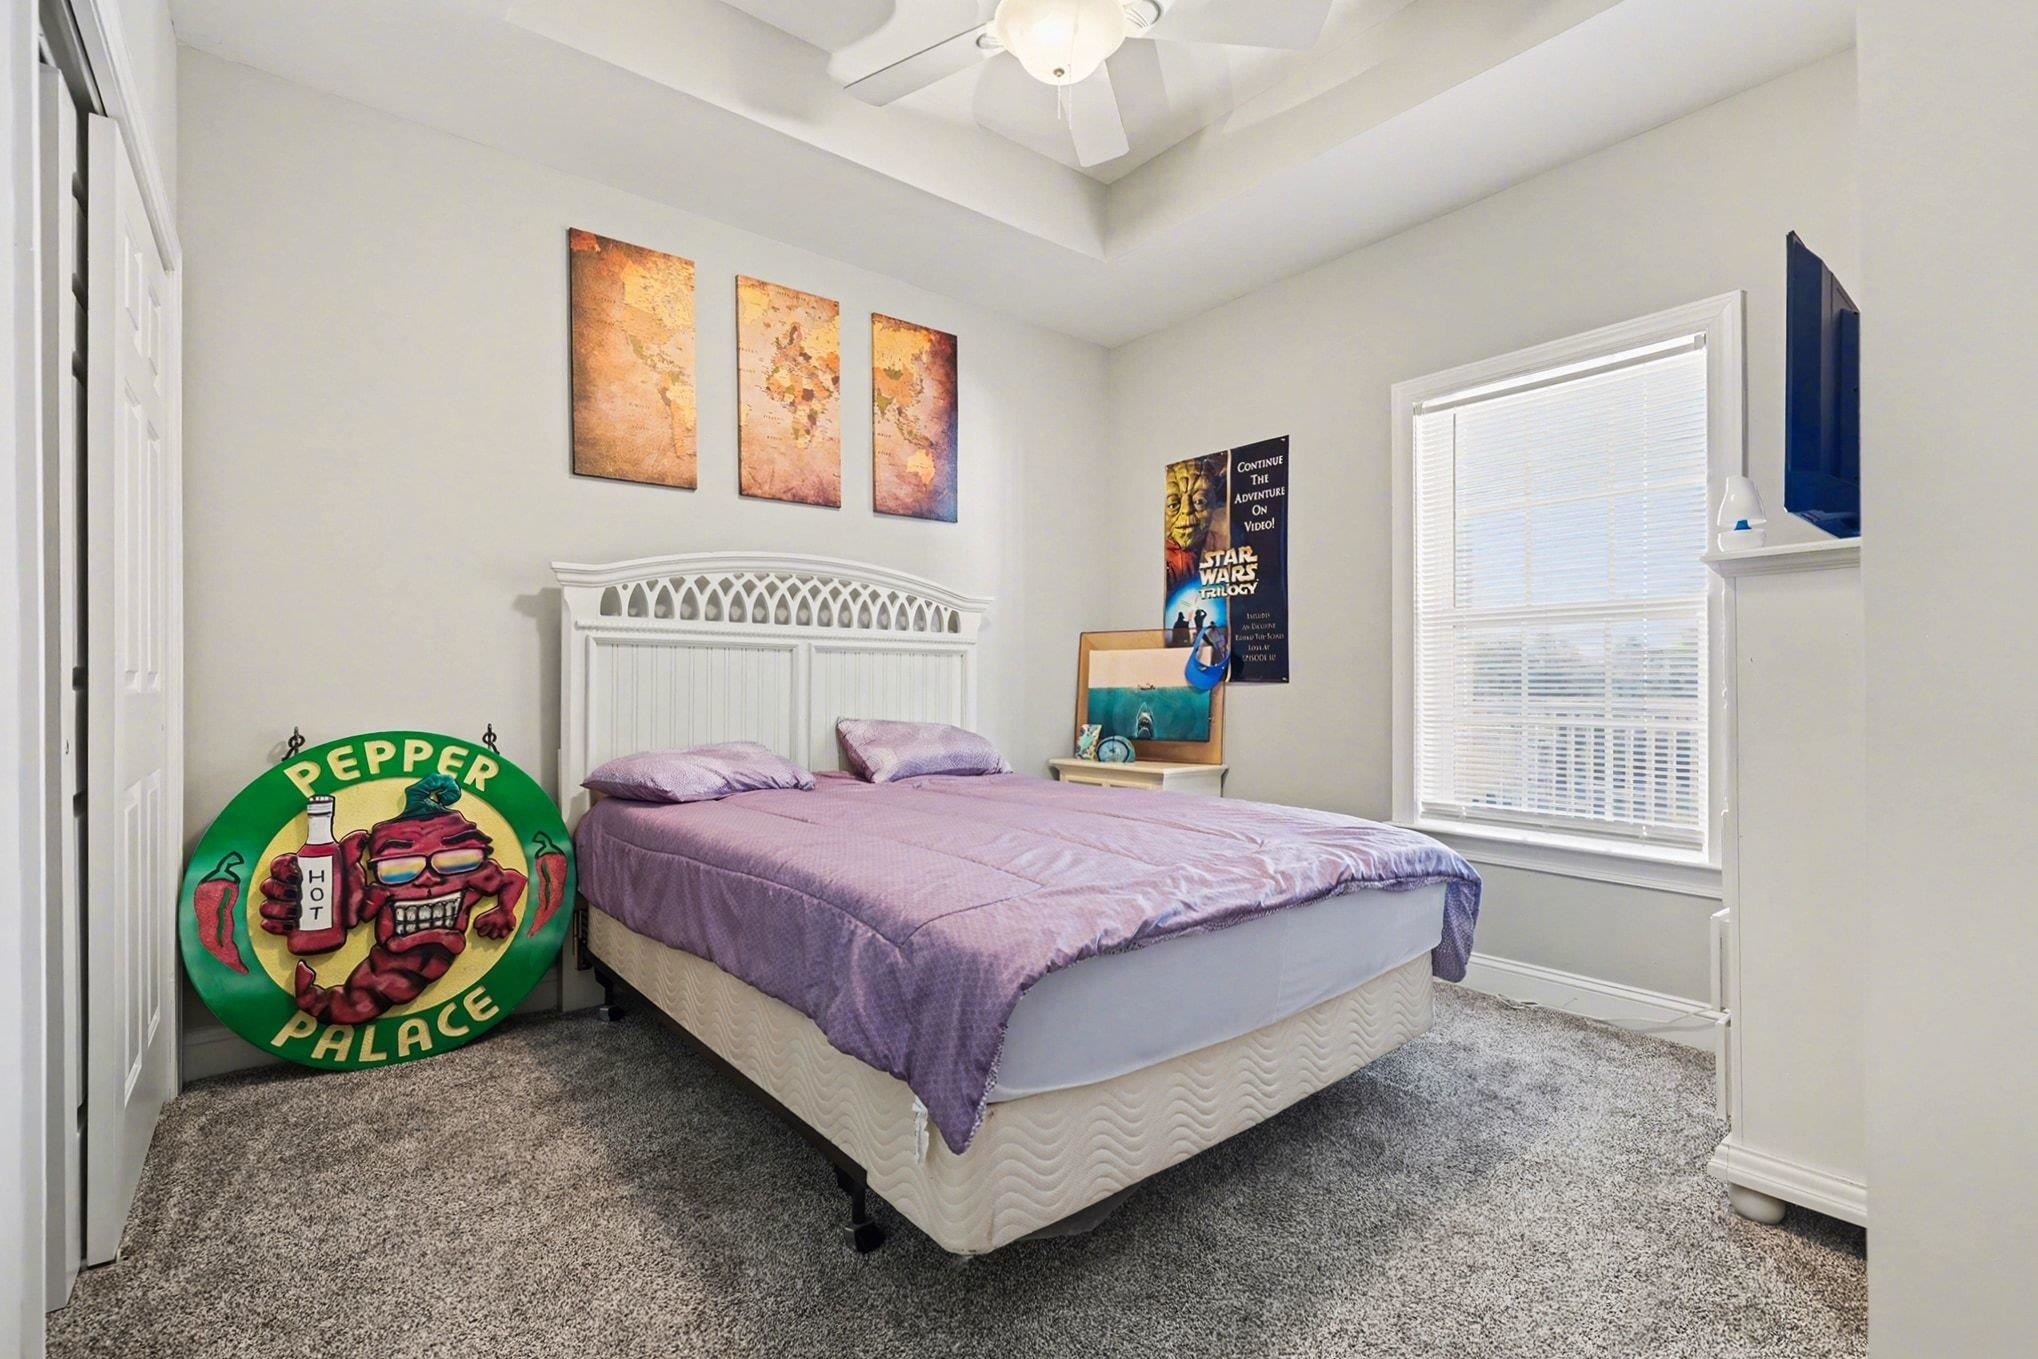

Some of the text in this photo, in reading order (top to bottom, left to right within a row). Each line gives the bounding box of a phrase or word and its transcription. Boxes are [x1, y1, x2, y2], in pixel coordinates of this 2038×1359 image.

[1237, 455, 1283, 473] CONTINUE
[1250, 474, 1269, 485] THE
[1234, 486, 1286, 504] ADVENTURE
[1252, 504, 1267, 515] ON
[1244, 517, 1275, 532] VIDEO!
[1199, 545, 1258, 568] STAR
[1199, 563, 1258, 586] WARS
[1200, 582, 1258, 599] TRILOGY
[283, 738, 500, 797] PEPPER
[309, 869, 325, 920] HOT
[270, 986, 500, 1062] PALACE
